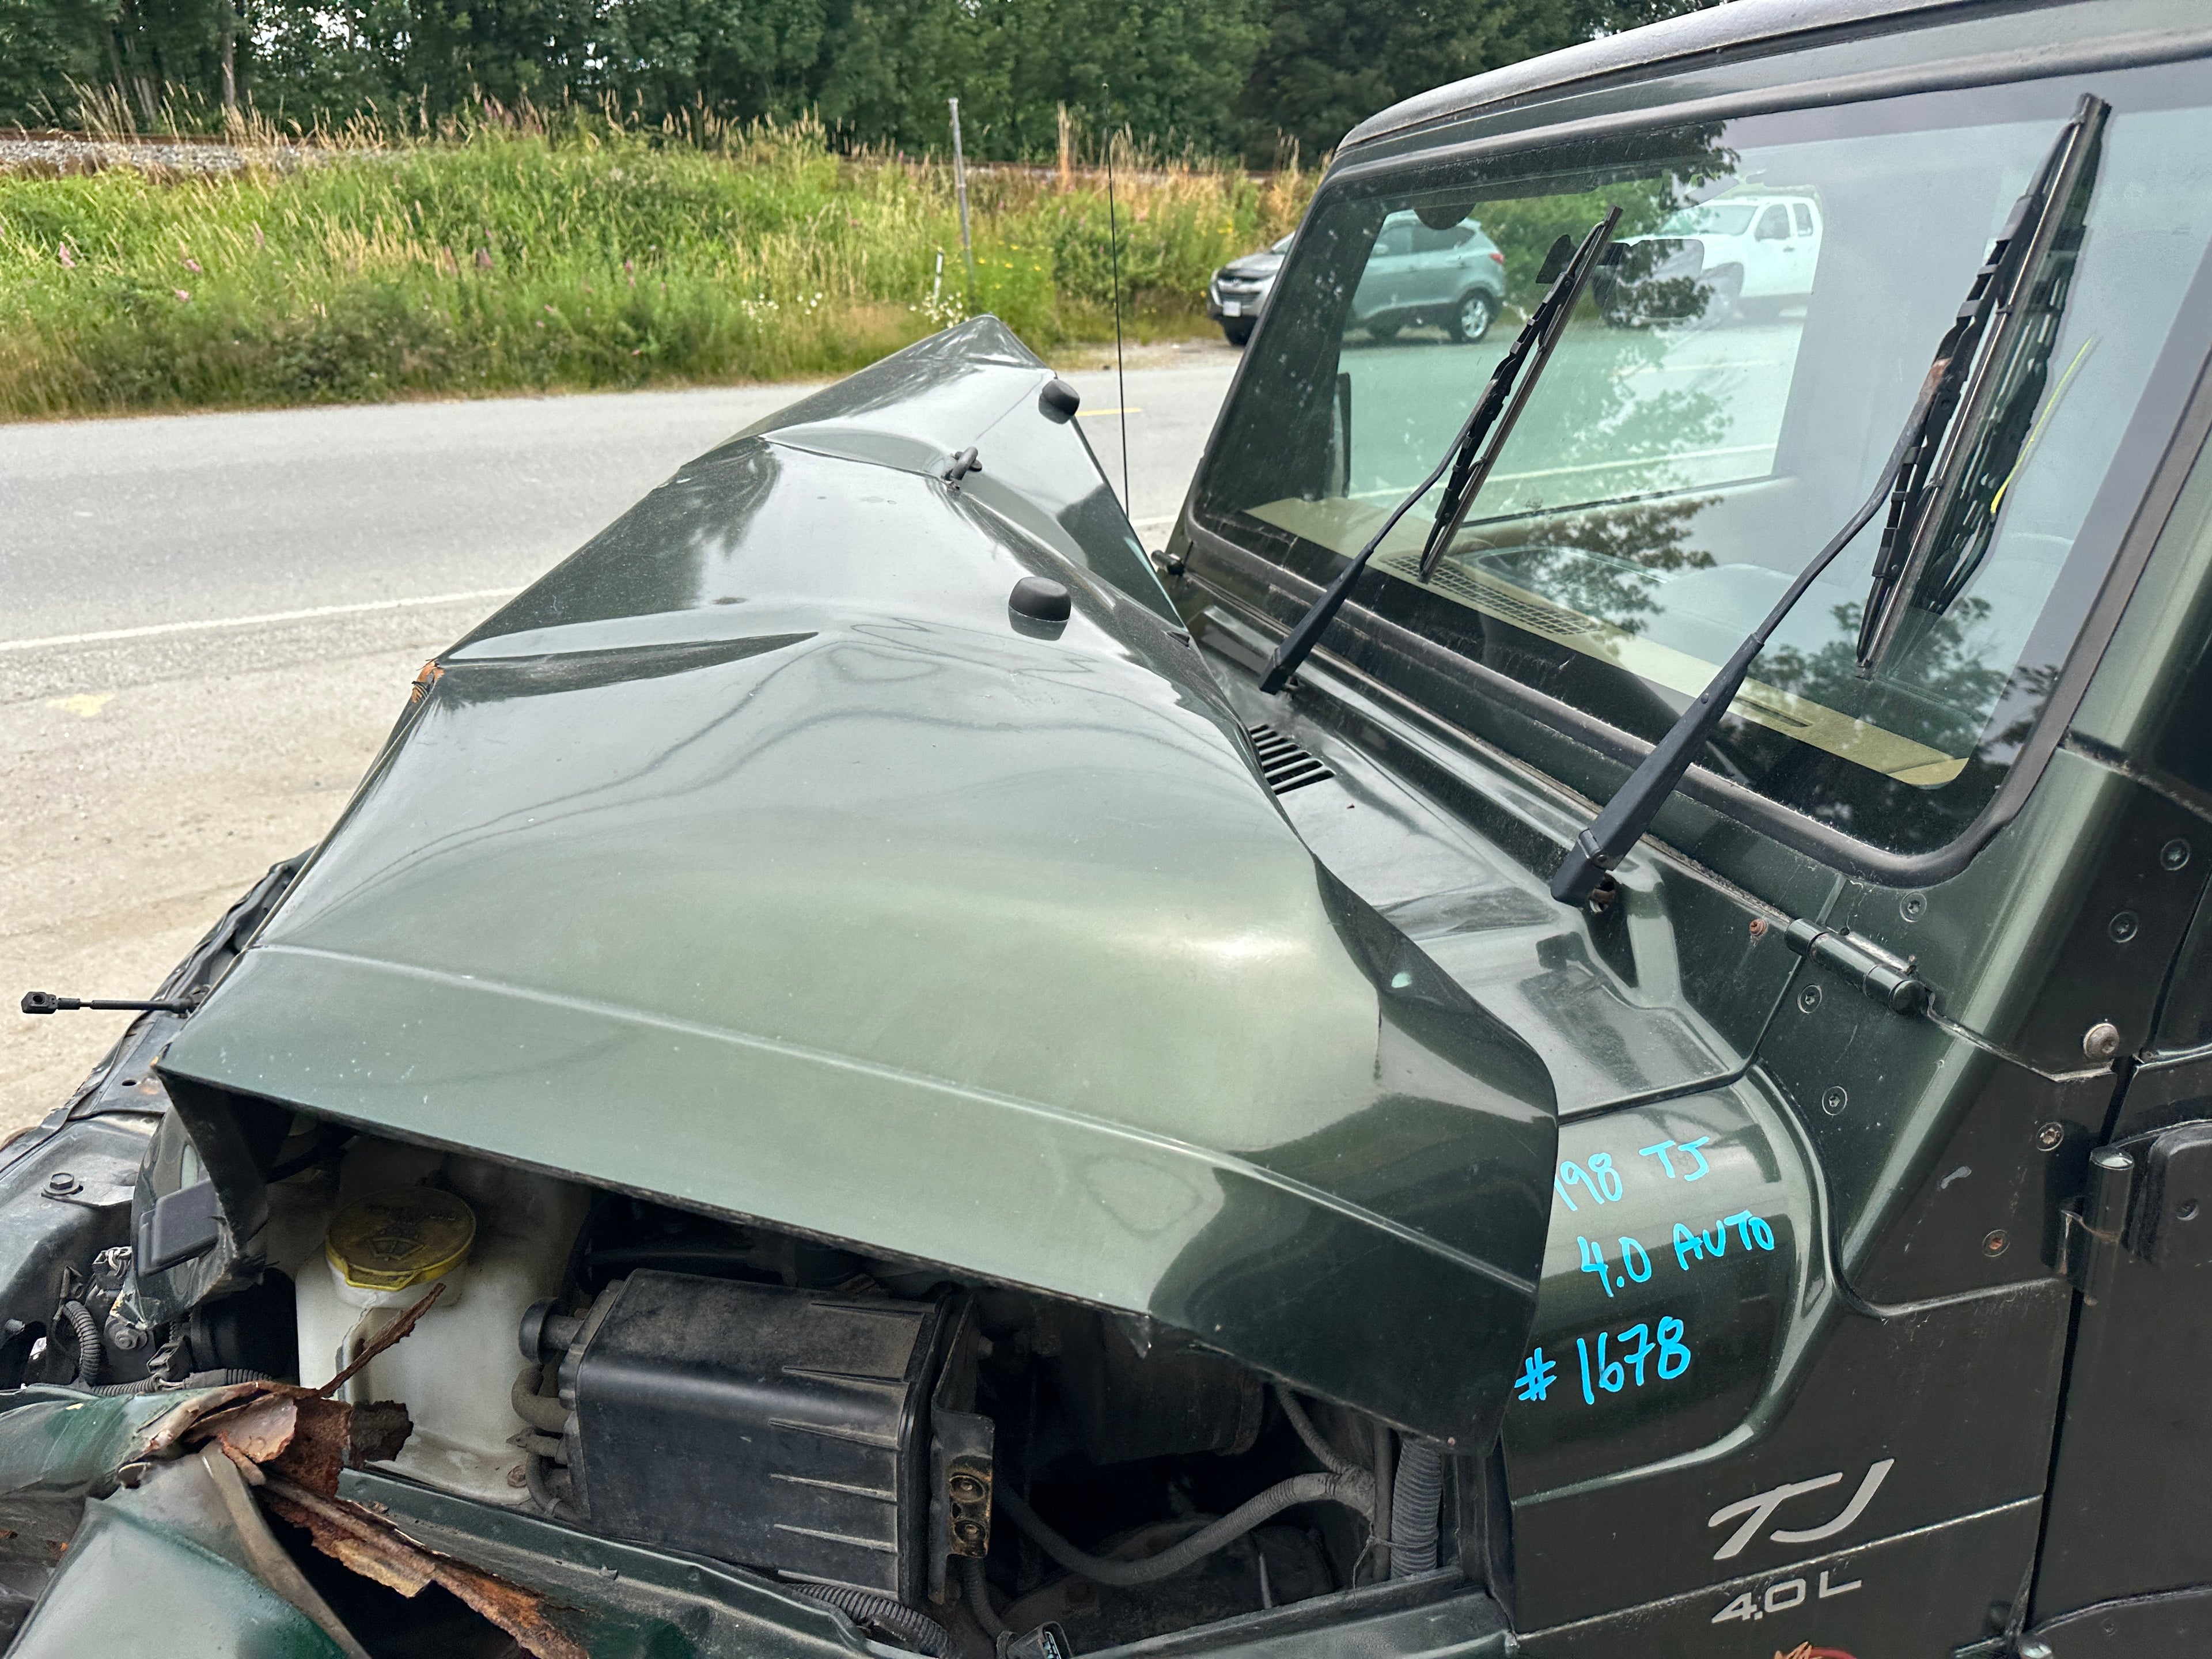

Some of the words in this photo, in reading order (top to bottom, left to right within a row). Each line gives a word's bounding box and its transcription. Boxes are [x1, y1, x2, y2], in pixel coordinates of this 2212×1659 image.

[1639, 1137, 1709, 1181] TJ
[1577, 1236, 1652, 1298] 4.0
[1673, 1210, 1775, 1271] AUTO
[1708, 1458, 1895, 1560] TJ
